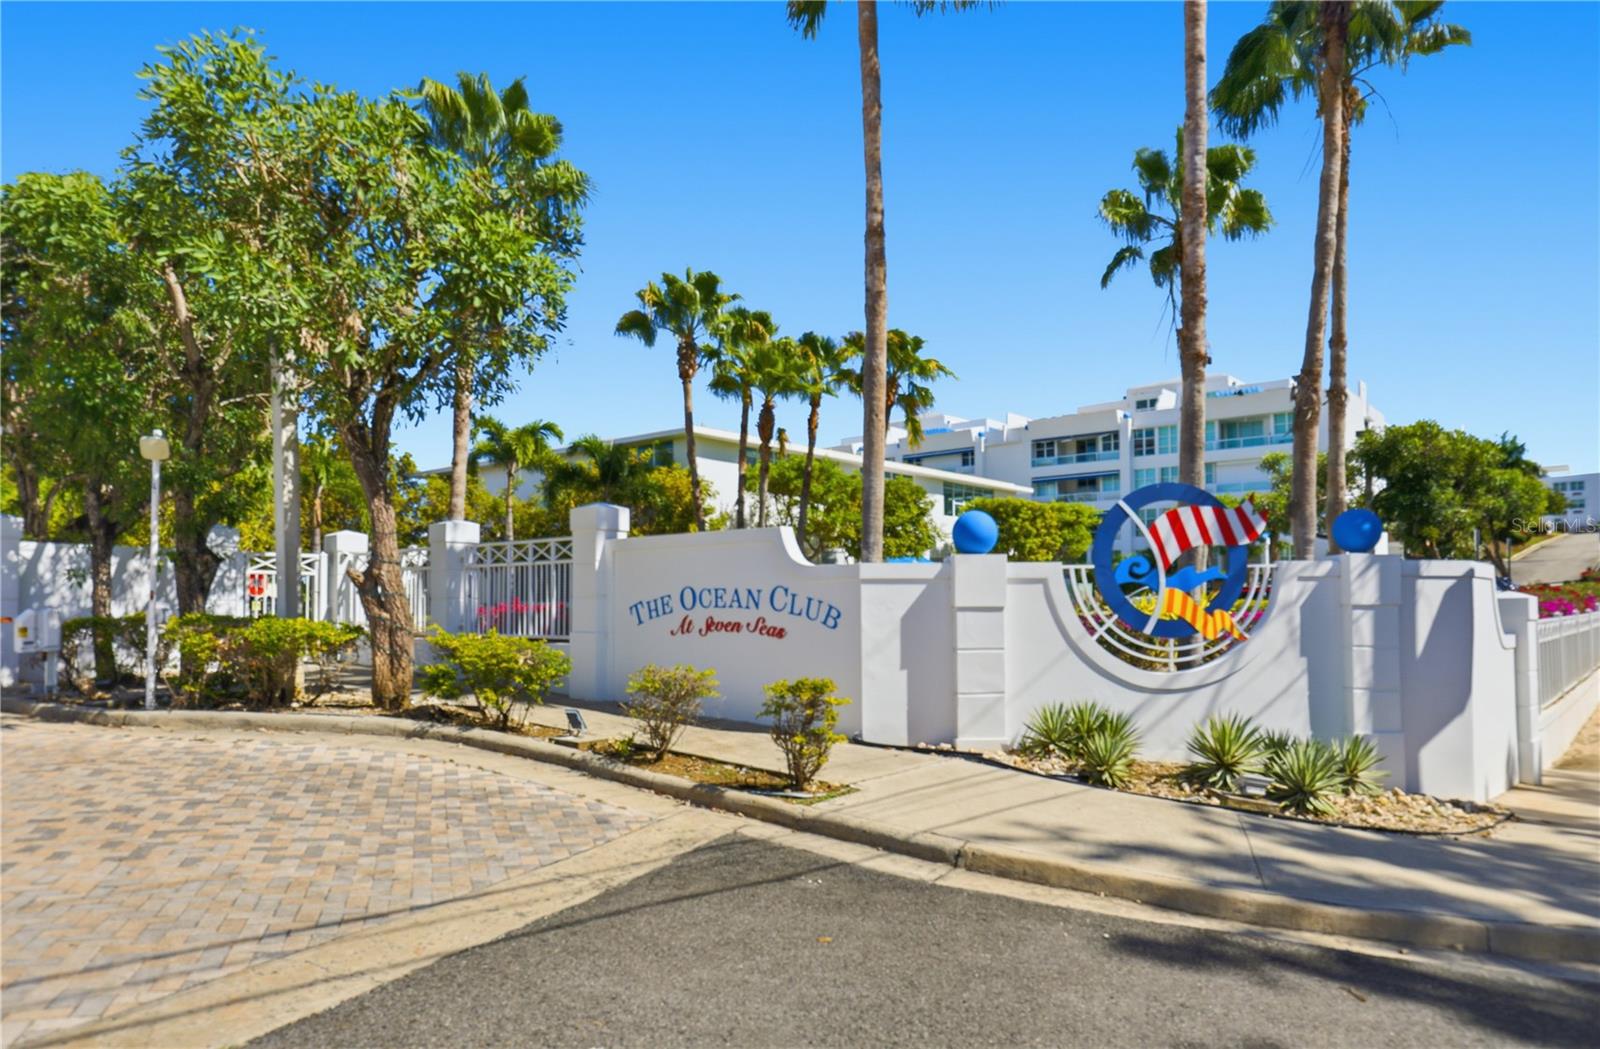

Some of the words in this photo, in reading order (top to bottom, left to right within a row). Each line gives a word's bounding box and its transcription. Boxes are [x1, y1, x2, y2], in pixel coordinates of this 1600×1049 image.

[629, 594, 673, 626] THE
[679, 586, 762, 611] OCEAN
[769, 585, 842, 630] CLUB
[670, 615, 694, 636] At
[698, 616, 742, 637] Seven
[746, 616, 787, 639] Seas
